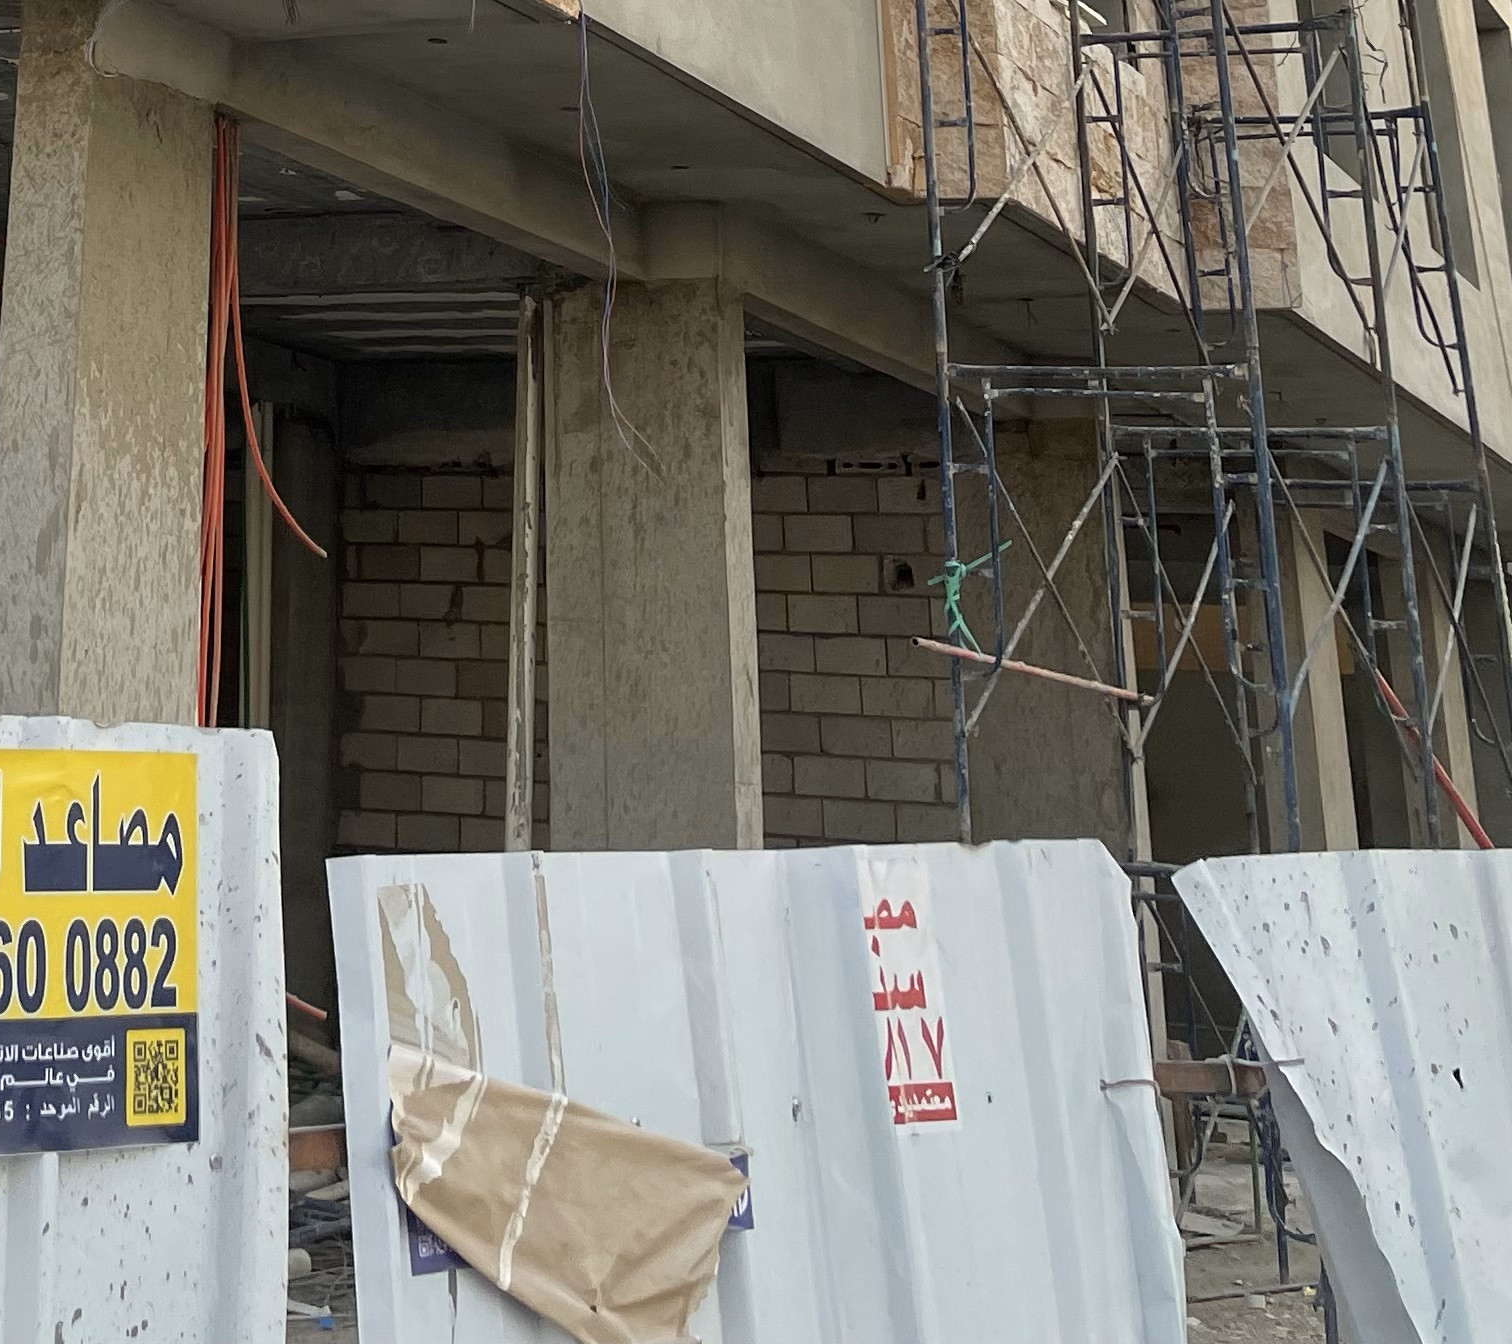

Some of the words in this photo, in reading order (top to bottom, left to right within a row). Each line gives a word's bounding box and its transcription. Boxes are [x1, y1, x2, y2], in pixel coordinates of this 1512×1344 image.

[23, 773, 183, 896] مصاعد
[65, 917, 178, 1012] 0882
[21, 1042, 79, 1062] صناعات
[81, 1035, 116, 1061] أقوى
